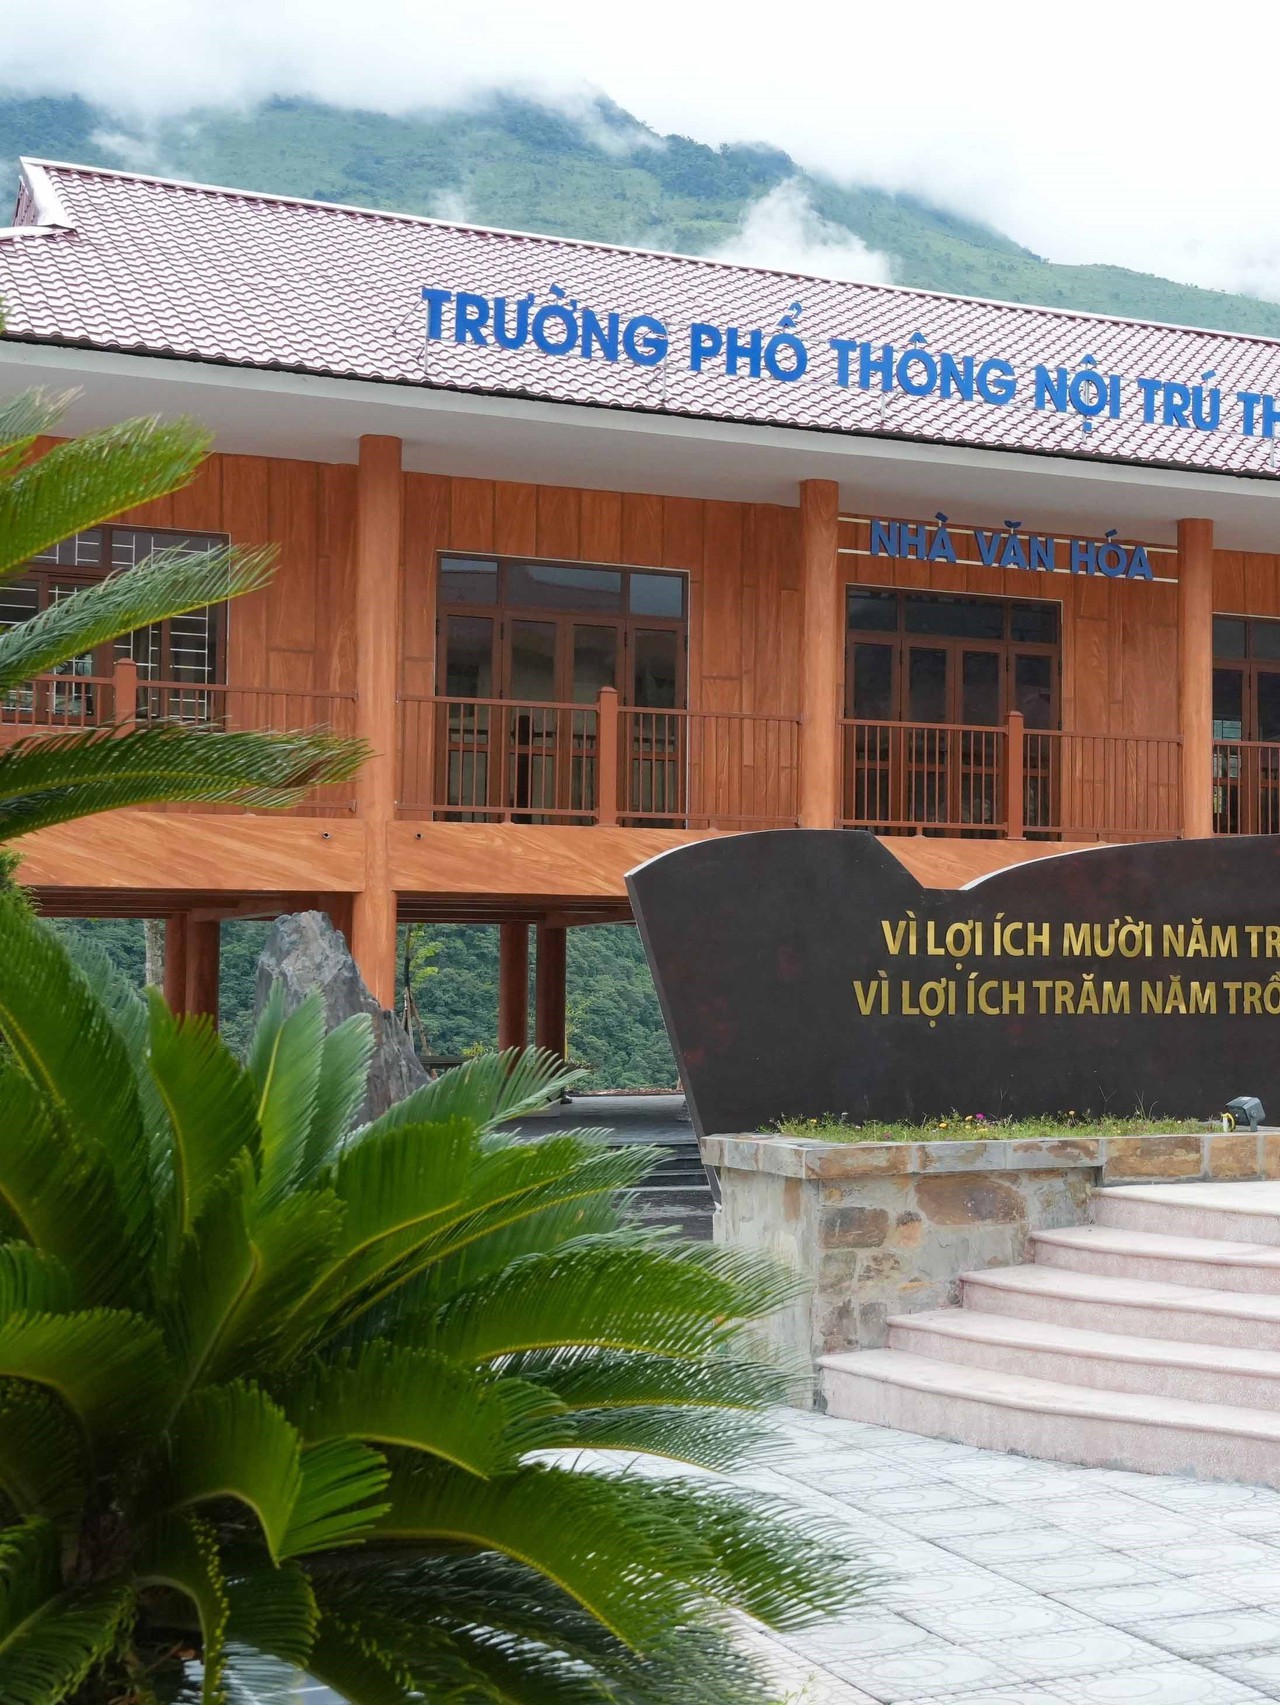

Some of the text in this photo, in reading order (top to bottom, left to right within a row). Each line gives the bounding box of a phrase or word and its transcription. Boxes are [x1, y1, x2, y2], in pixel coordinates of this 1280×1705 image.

[422, 283, 669, 366] TRƯỜNG
[690, 301, 808, 382] PHỔ
[829, 331, 1015, 405] THÔNG
[1034, 353, 1121, 432] NỘI
[1136, 370, 1221, 432] TRÚ
[870, 511, 1154, 580] NHÀ VĂN HÓA
[881, 910, 917, 956] VÌ
[927, 919, 983, 971] LỢI
[993, 912, 1050, 956] ÍCH
[1062, 915, 1152, 958] MƯỜI
[1162, 917, 1238, 958] NĂM
[852, 969, 889, 1016] VÌ
[901, 977, 956, 1028] LỢI
[967, 972, 1025, 1015] ÍCH
[1032, 973, 1131, 1015] TRĂM
[1140, 974, 1217, 1015] NĂM
